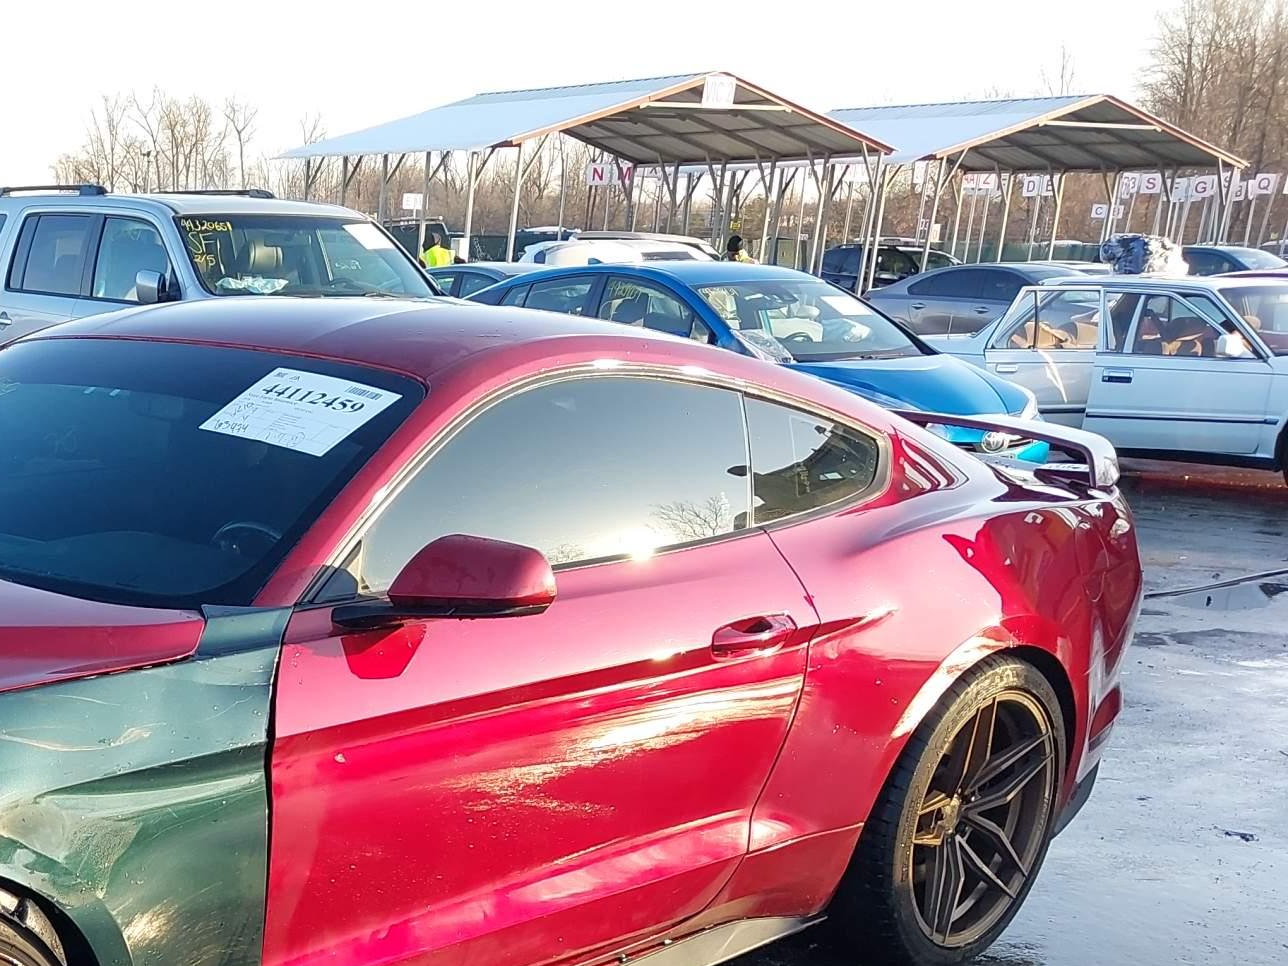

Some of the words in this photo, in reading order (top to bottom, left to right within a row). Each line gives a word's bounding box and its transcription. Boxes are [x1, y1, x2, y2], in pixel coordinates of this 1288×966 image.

[592, 167, 604, 181] N
[1026, 180, 1036, 192] D
[1145, 177, 1157, 190] S
[1194, 181, 1207, 194] G
[1257, 177, 1271, 191] Q
[1095, 206, 1103, 216] C
[261, 383, 366, 414] 44112459
